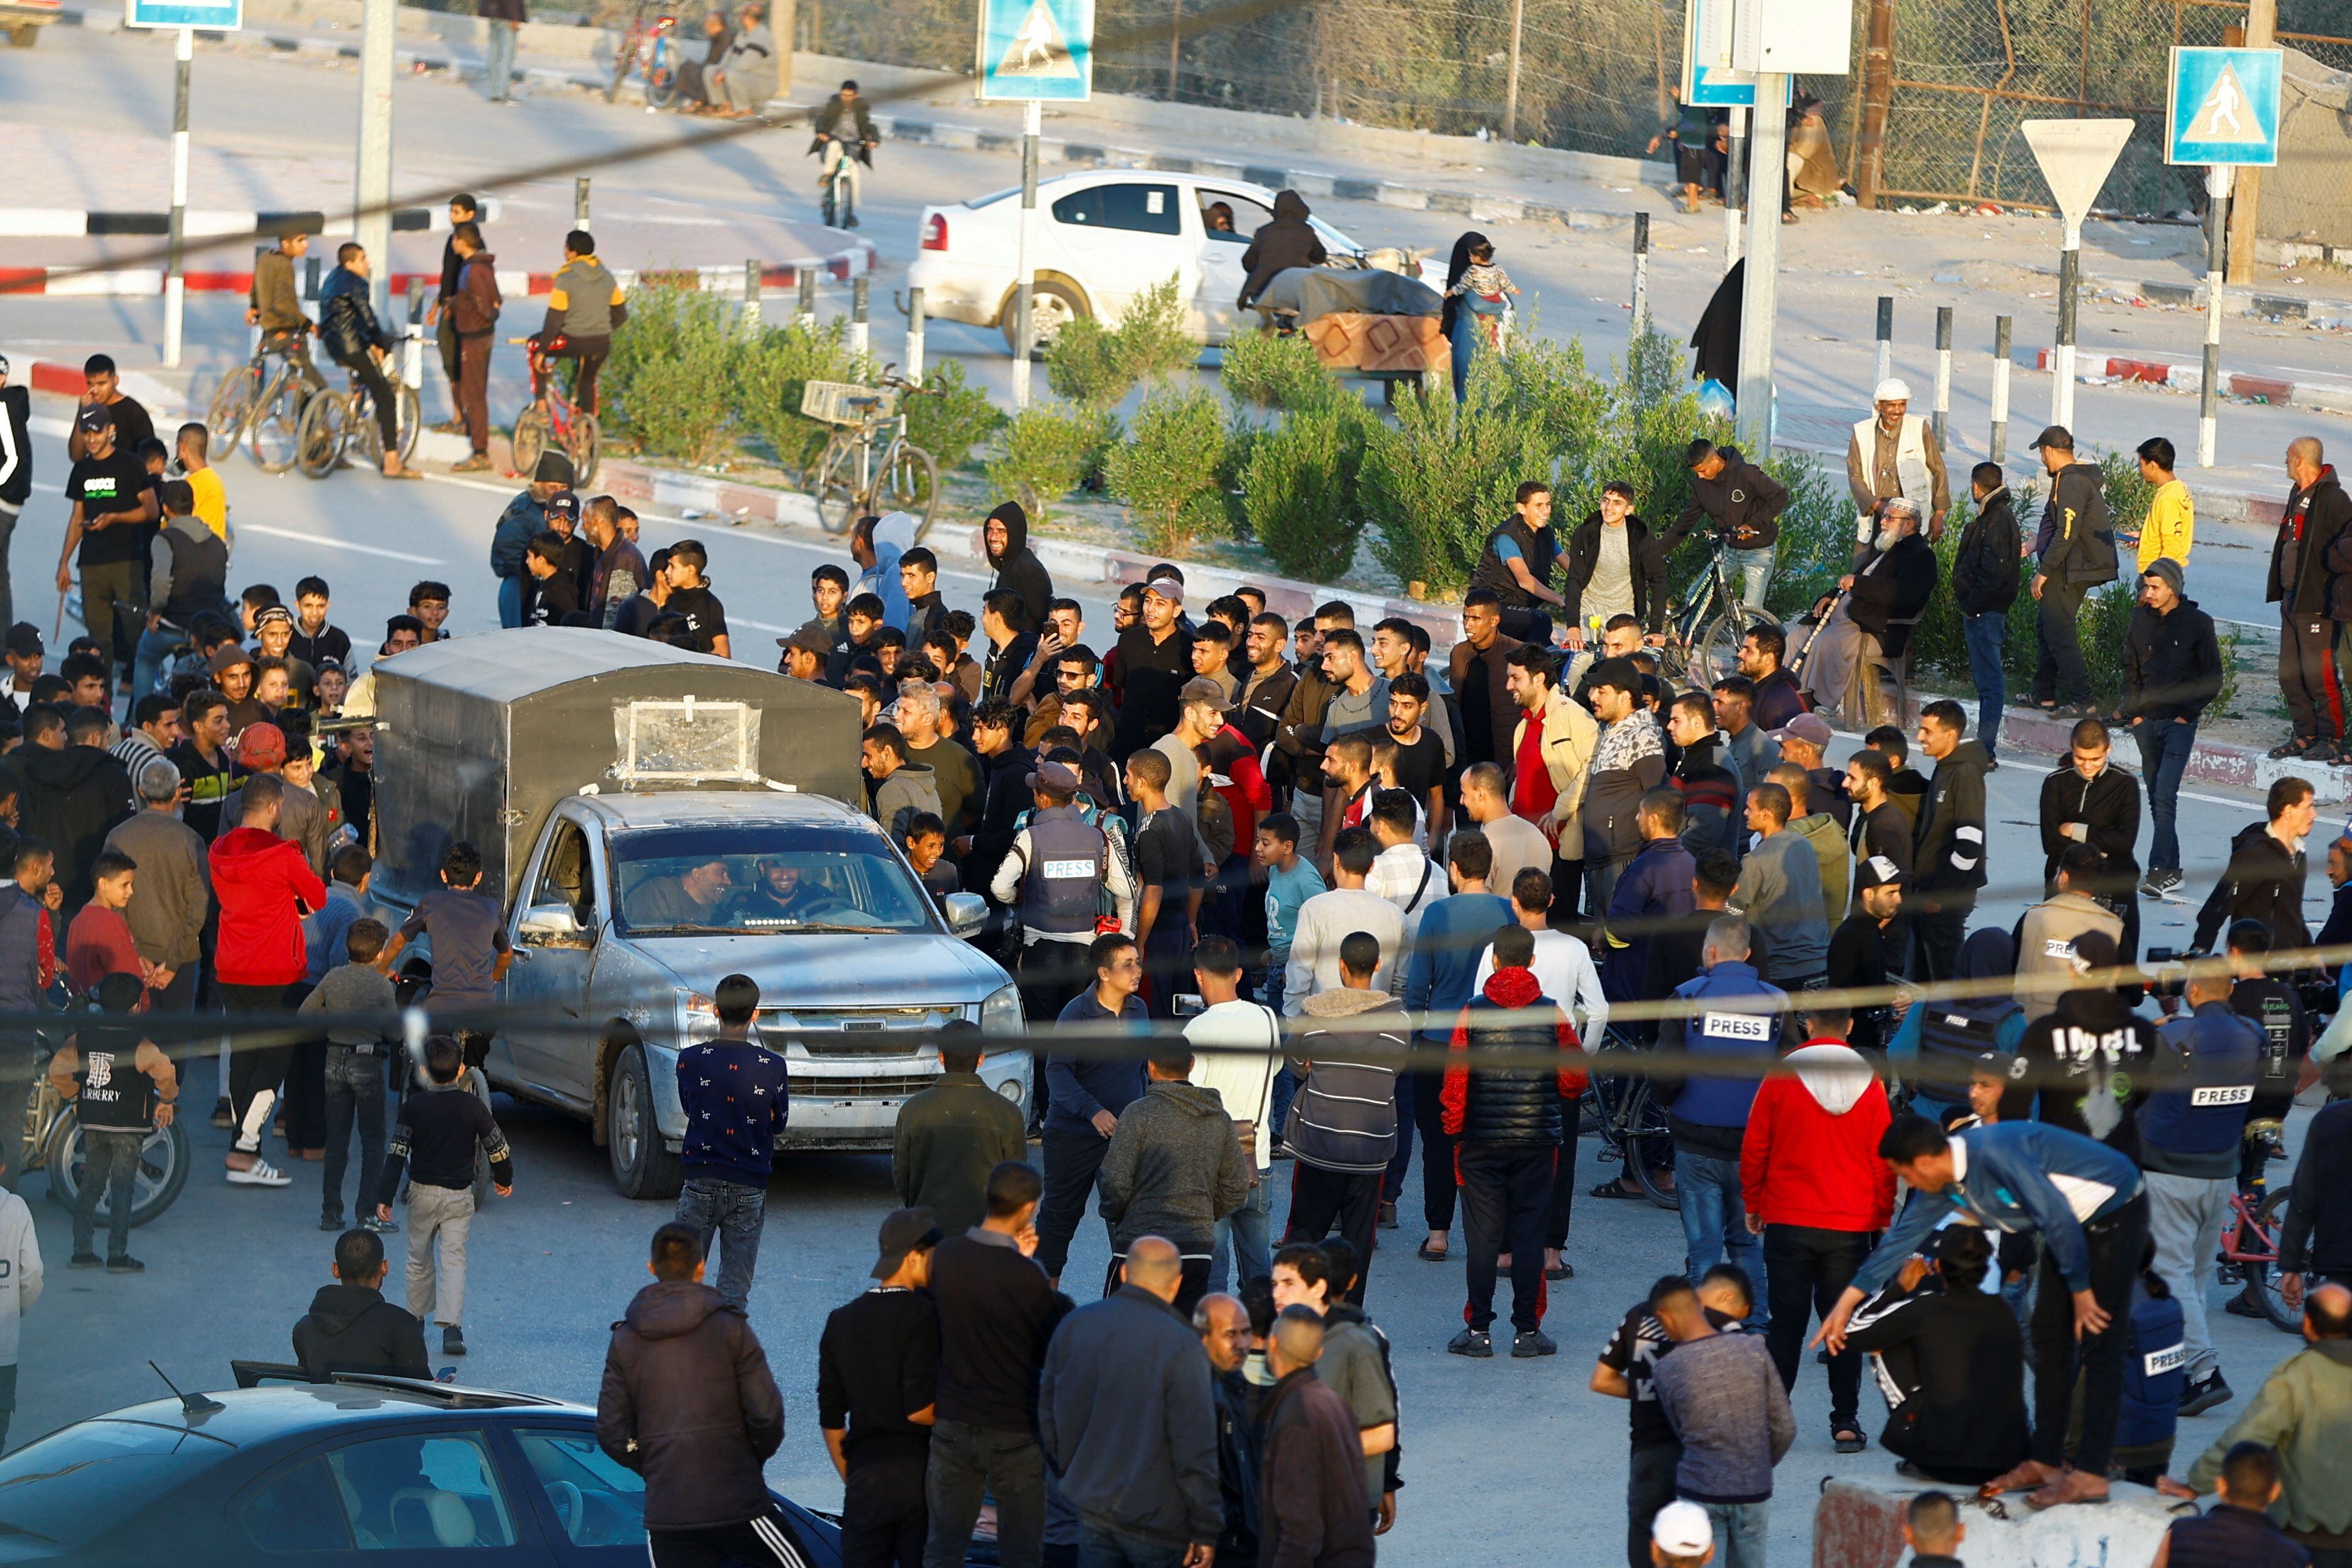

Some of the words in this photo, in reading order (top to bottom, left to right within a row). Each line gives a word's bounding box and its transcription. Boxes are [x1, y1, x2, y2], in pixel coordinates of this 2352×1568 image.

[1046, 861, 1093, 877] PRESS
[2047, 942, 2072, 956] PRE
[1711, 1019, 1761, 1036] PRESS
[1946, 1015, 1968, 1027] PRESS
[2197, 1089, 2247, 1103] PRESS
[2152, 1349, 2185, 1370] PRESS
